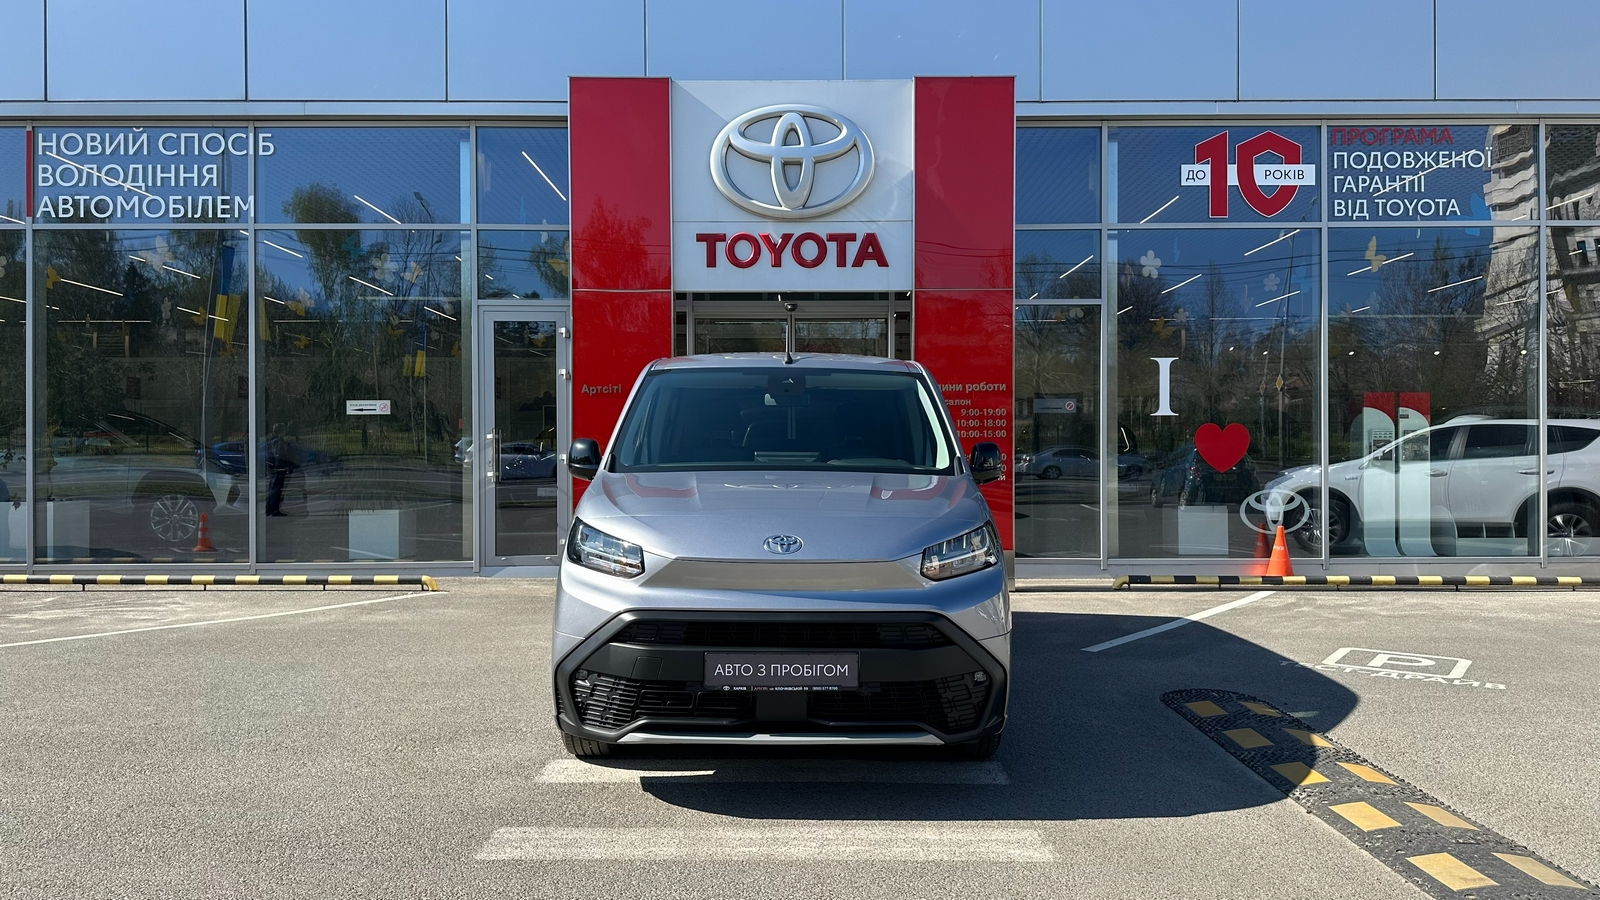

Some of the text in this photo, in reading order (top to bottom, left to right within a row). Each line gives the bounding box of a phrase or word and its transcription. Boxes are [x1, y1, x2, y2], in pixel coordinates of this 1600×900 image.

[38, 127, 275, 156] НОВИЙ СПОСІБ
[1332, 127, 1454, 145] ПРОГРАМА
[1333, 147, 1493, 171] ПОДОВЖЕНОЇ
[38, 164, 218, 192] ВОЛОДІННЯ
[1185, 169, 1206, 182] ДО
[1264, 169, 1305, 180] РОКІВ
[1333, 171, 1425, 193] ГАРАНТІЇ
[36, 195, 254, 219] АВТОМОБІЛЕМ
[1333, 199, 1461, 220] ВІД TOYOTA
[696, 231, 890, 269] TOYOTA
[581, 383, 622, 396] Артсіті
[966, 382, 1006, 393] роботи
[961, 408, 1007, 416] 9:00-19:00
[957, 419, 1007, 427] 10:00-18:00
[957, 430, 1007, 438] 10:00-15:00
[714, 663, 753, 677] АВТО
[770, 664, 849, 677] ПРОБІГОМ
